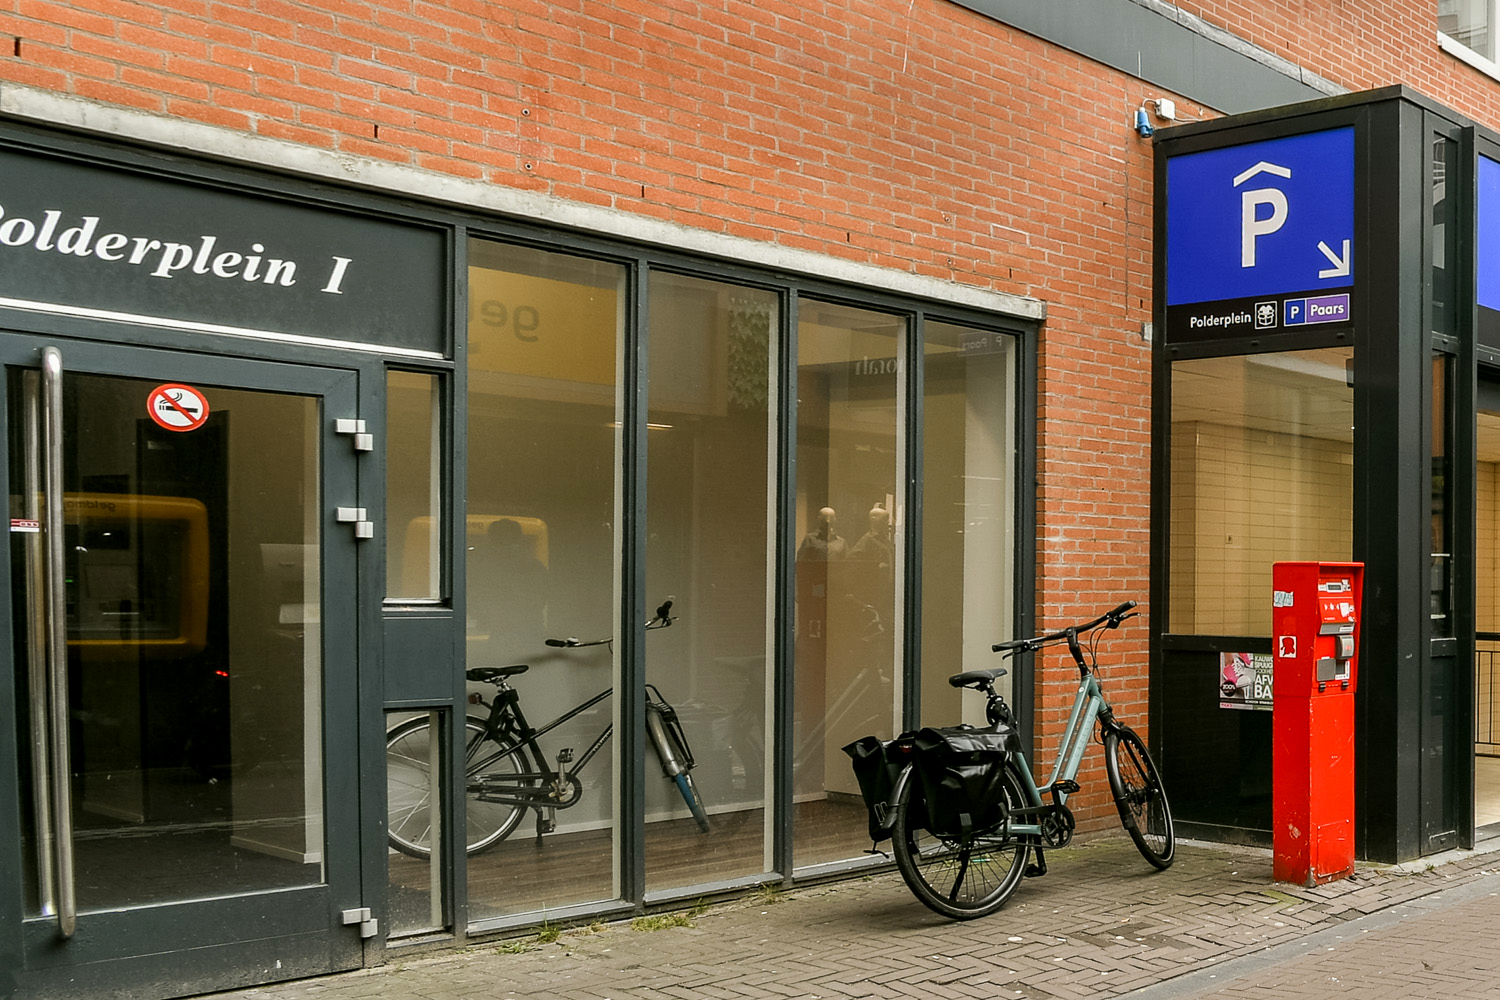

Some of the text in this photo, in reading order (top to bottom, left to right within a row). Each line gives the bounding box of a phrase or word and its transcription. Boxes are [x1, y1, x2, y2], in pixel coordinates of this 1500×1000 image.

[0, 204, 297, 287] olderplein
[1241, 187, 1289, 268] P
[1190, 311, 1252, 329] Polderplein
[1290, 302, 1345, 319] P Paars
